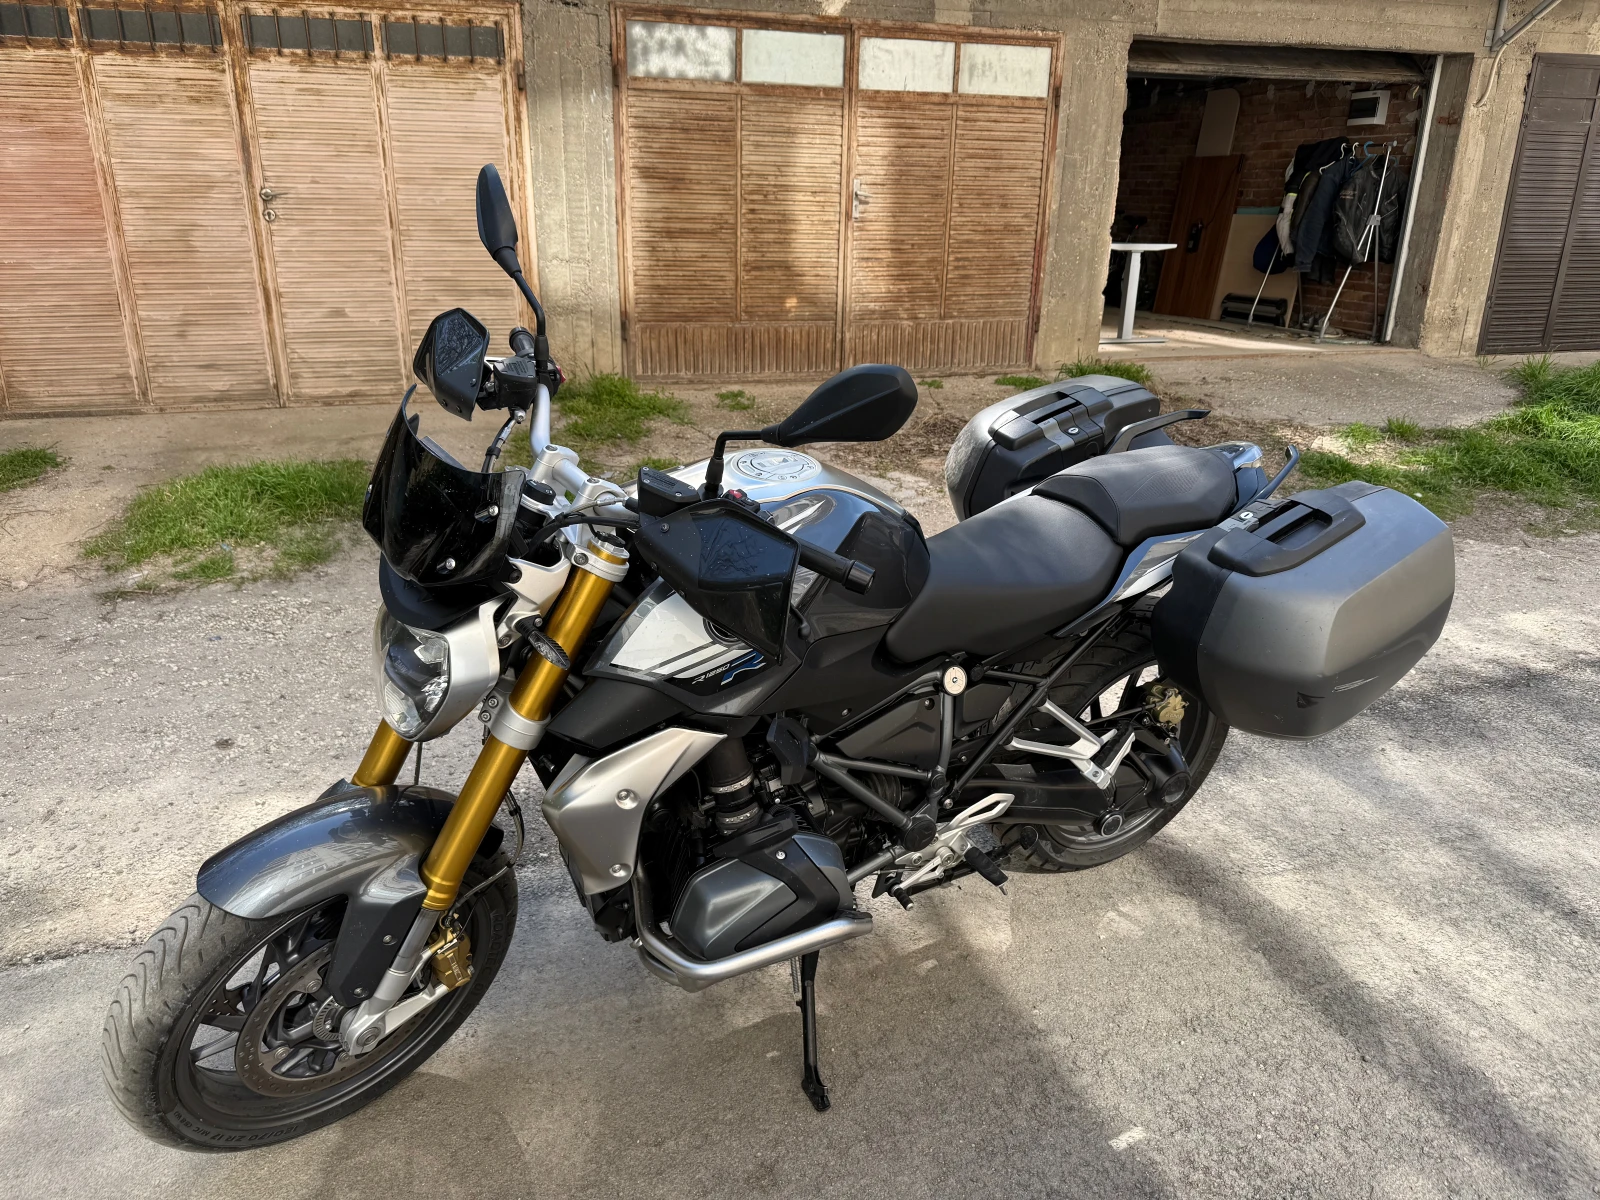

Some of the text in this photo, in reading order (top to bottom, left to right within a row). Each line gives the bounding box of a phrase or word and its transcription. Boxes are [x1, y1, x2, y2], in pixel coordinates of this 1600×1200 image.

[394, 659, 408, 674] BMW
[481, 913, 504, 976] ROADTEC
[193, 1127, 211, 1137] M/C
[209, 1133, 225, 1142] 17
